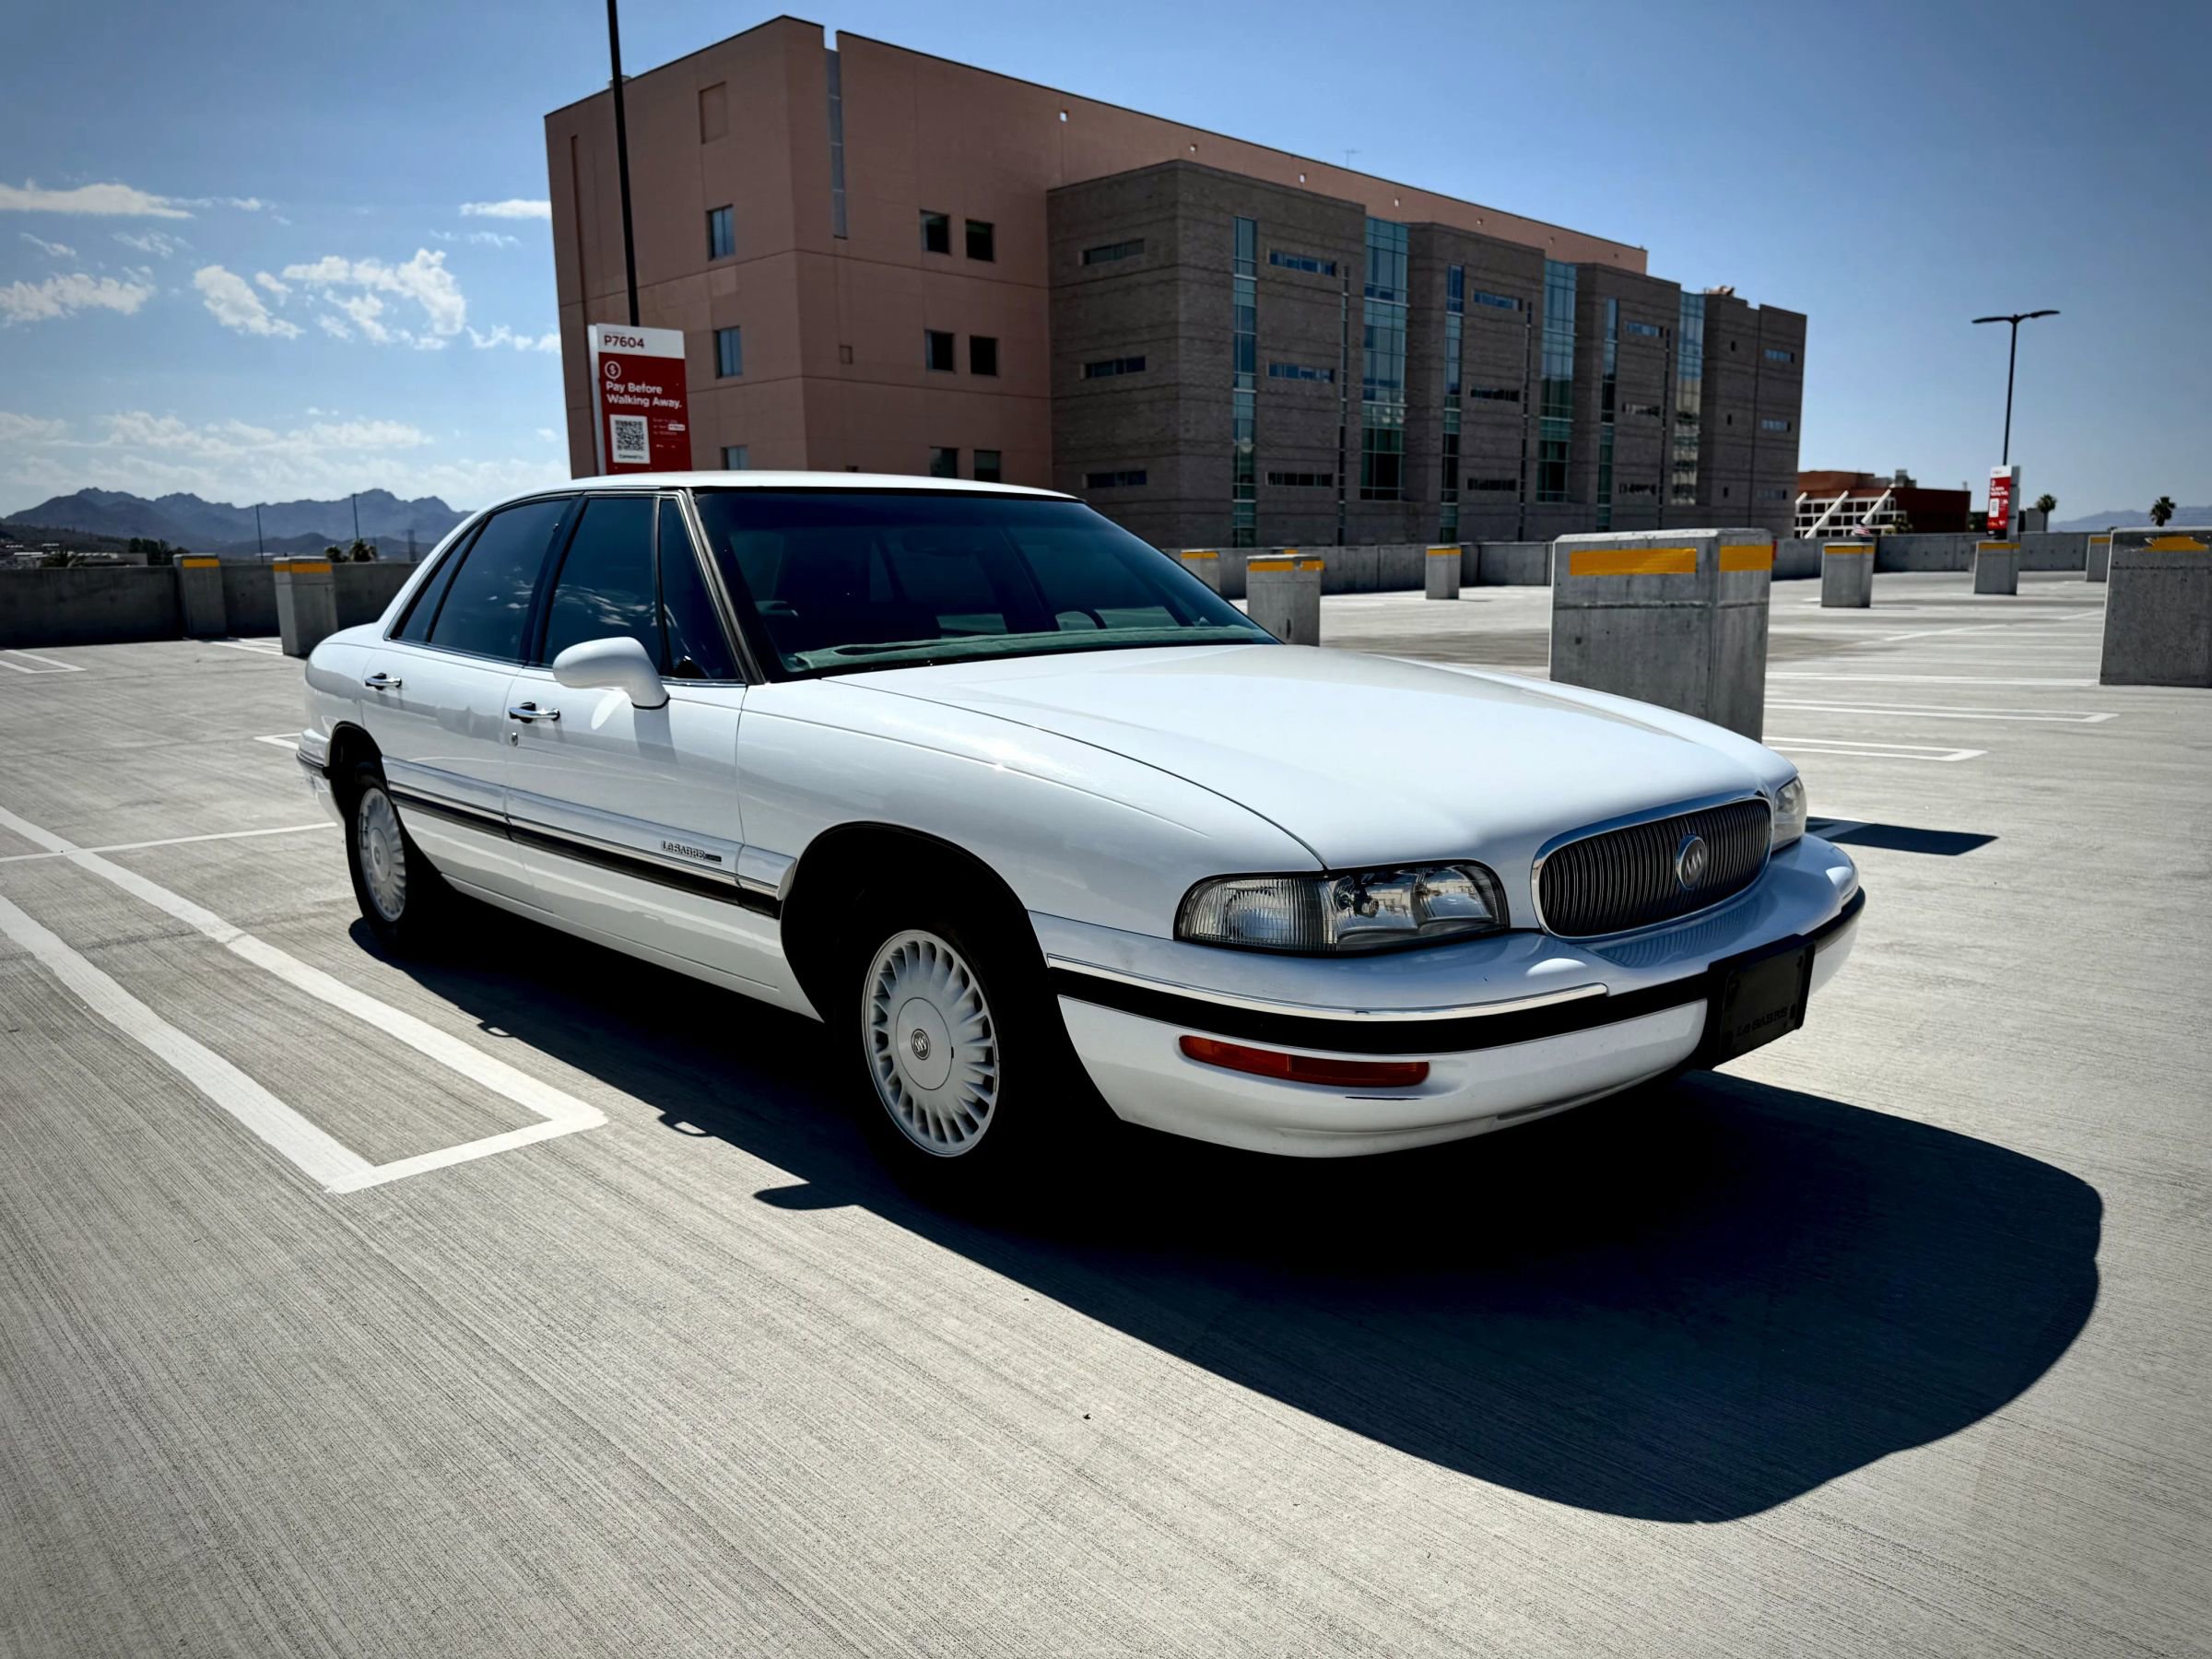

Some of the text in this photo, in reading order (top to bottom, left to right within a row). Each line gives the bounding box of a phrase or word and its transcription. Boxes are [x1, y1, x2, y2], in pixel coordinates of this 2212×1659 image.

[604, 335, 644, 349] P7604
[606, 382, 663, 394] Pay Before
[606, 394, 682, 409] Walking Away.
